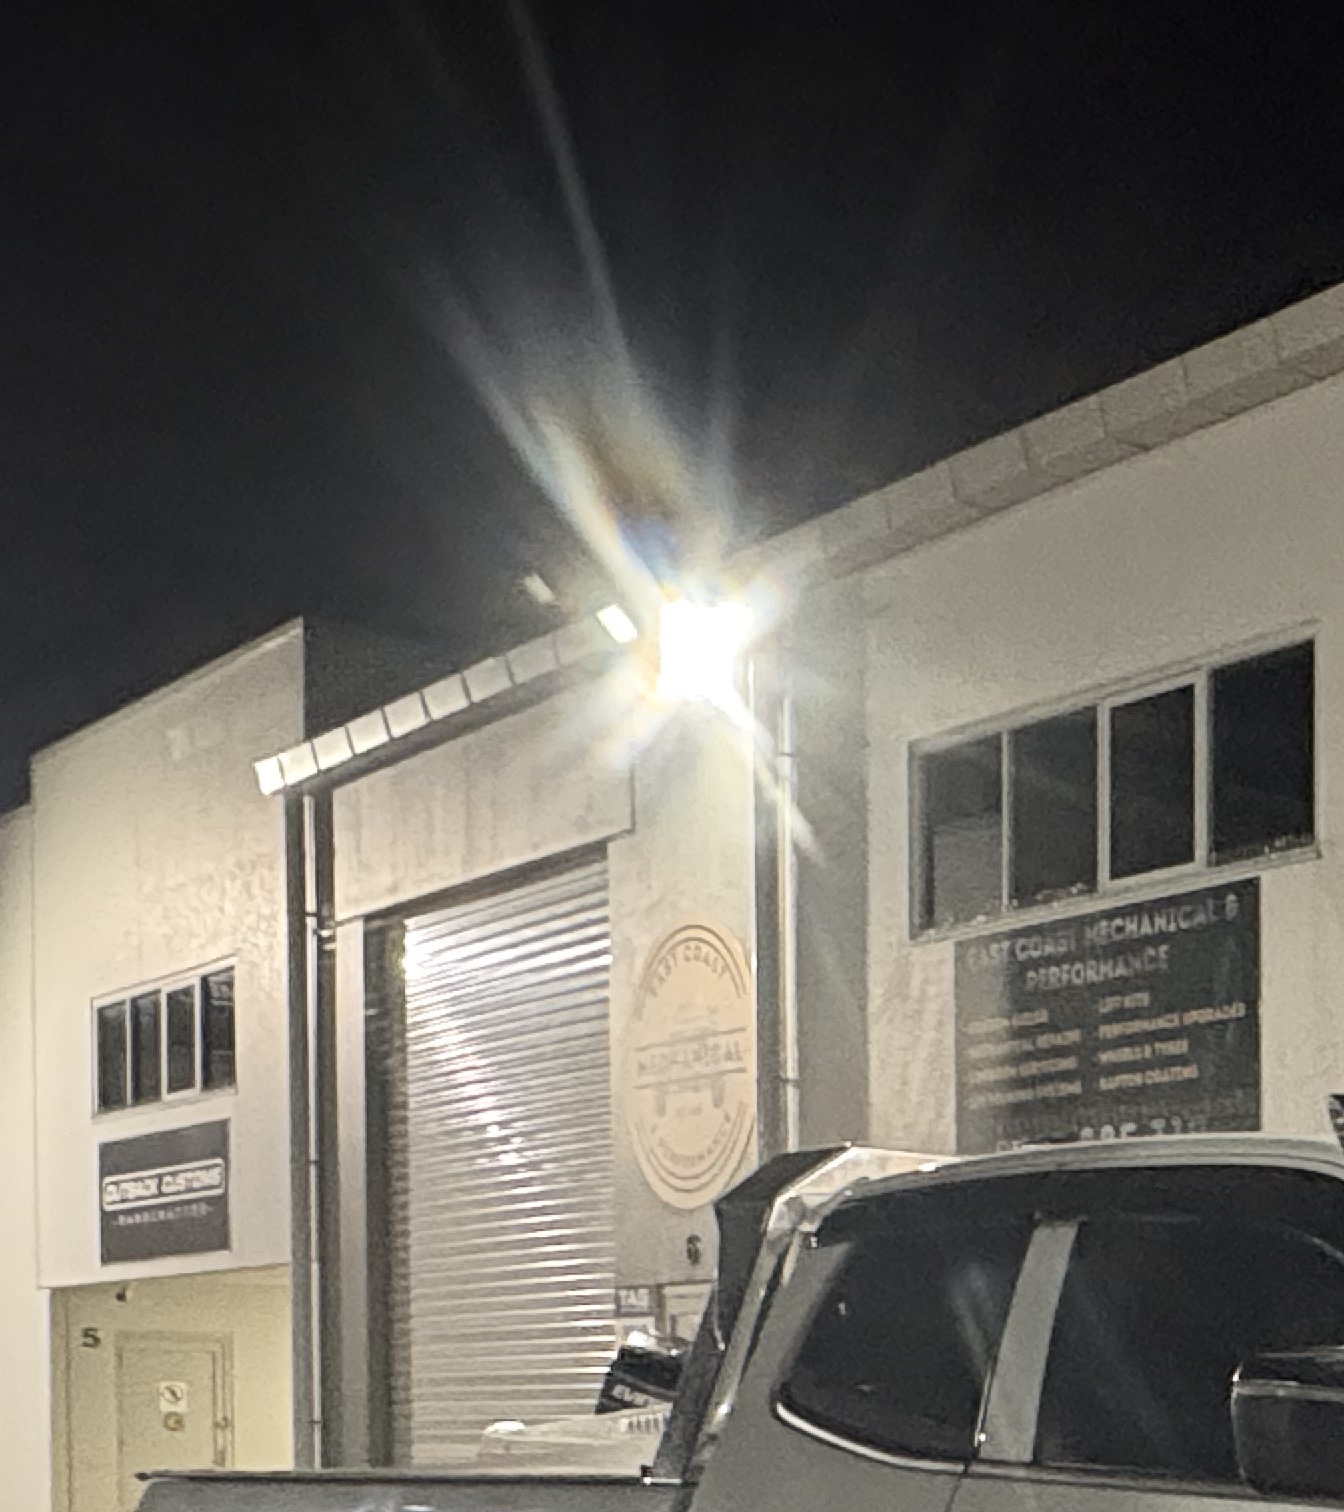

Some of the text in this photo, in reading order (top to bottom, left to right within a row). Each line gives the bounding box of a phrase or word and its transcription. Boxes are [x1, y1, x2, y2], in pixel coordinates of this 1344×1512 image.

[1084, 896, 1219, 947] MECHANICAL
[1025, 944, 1171, 991] PERFORMANCE
[81, 1327, 101, 1348] 5
